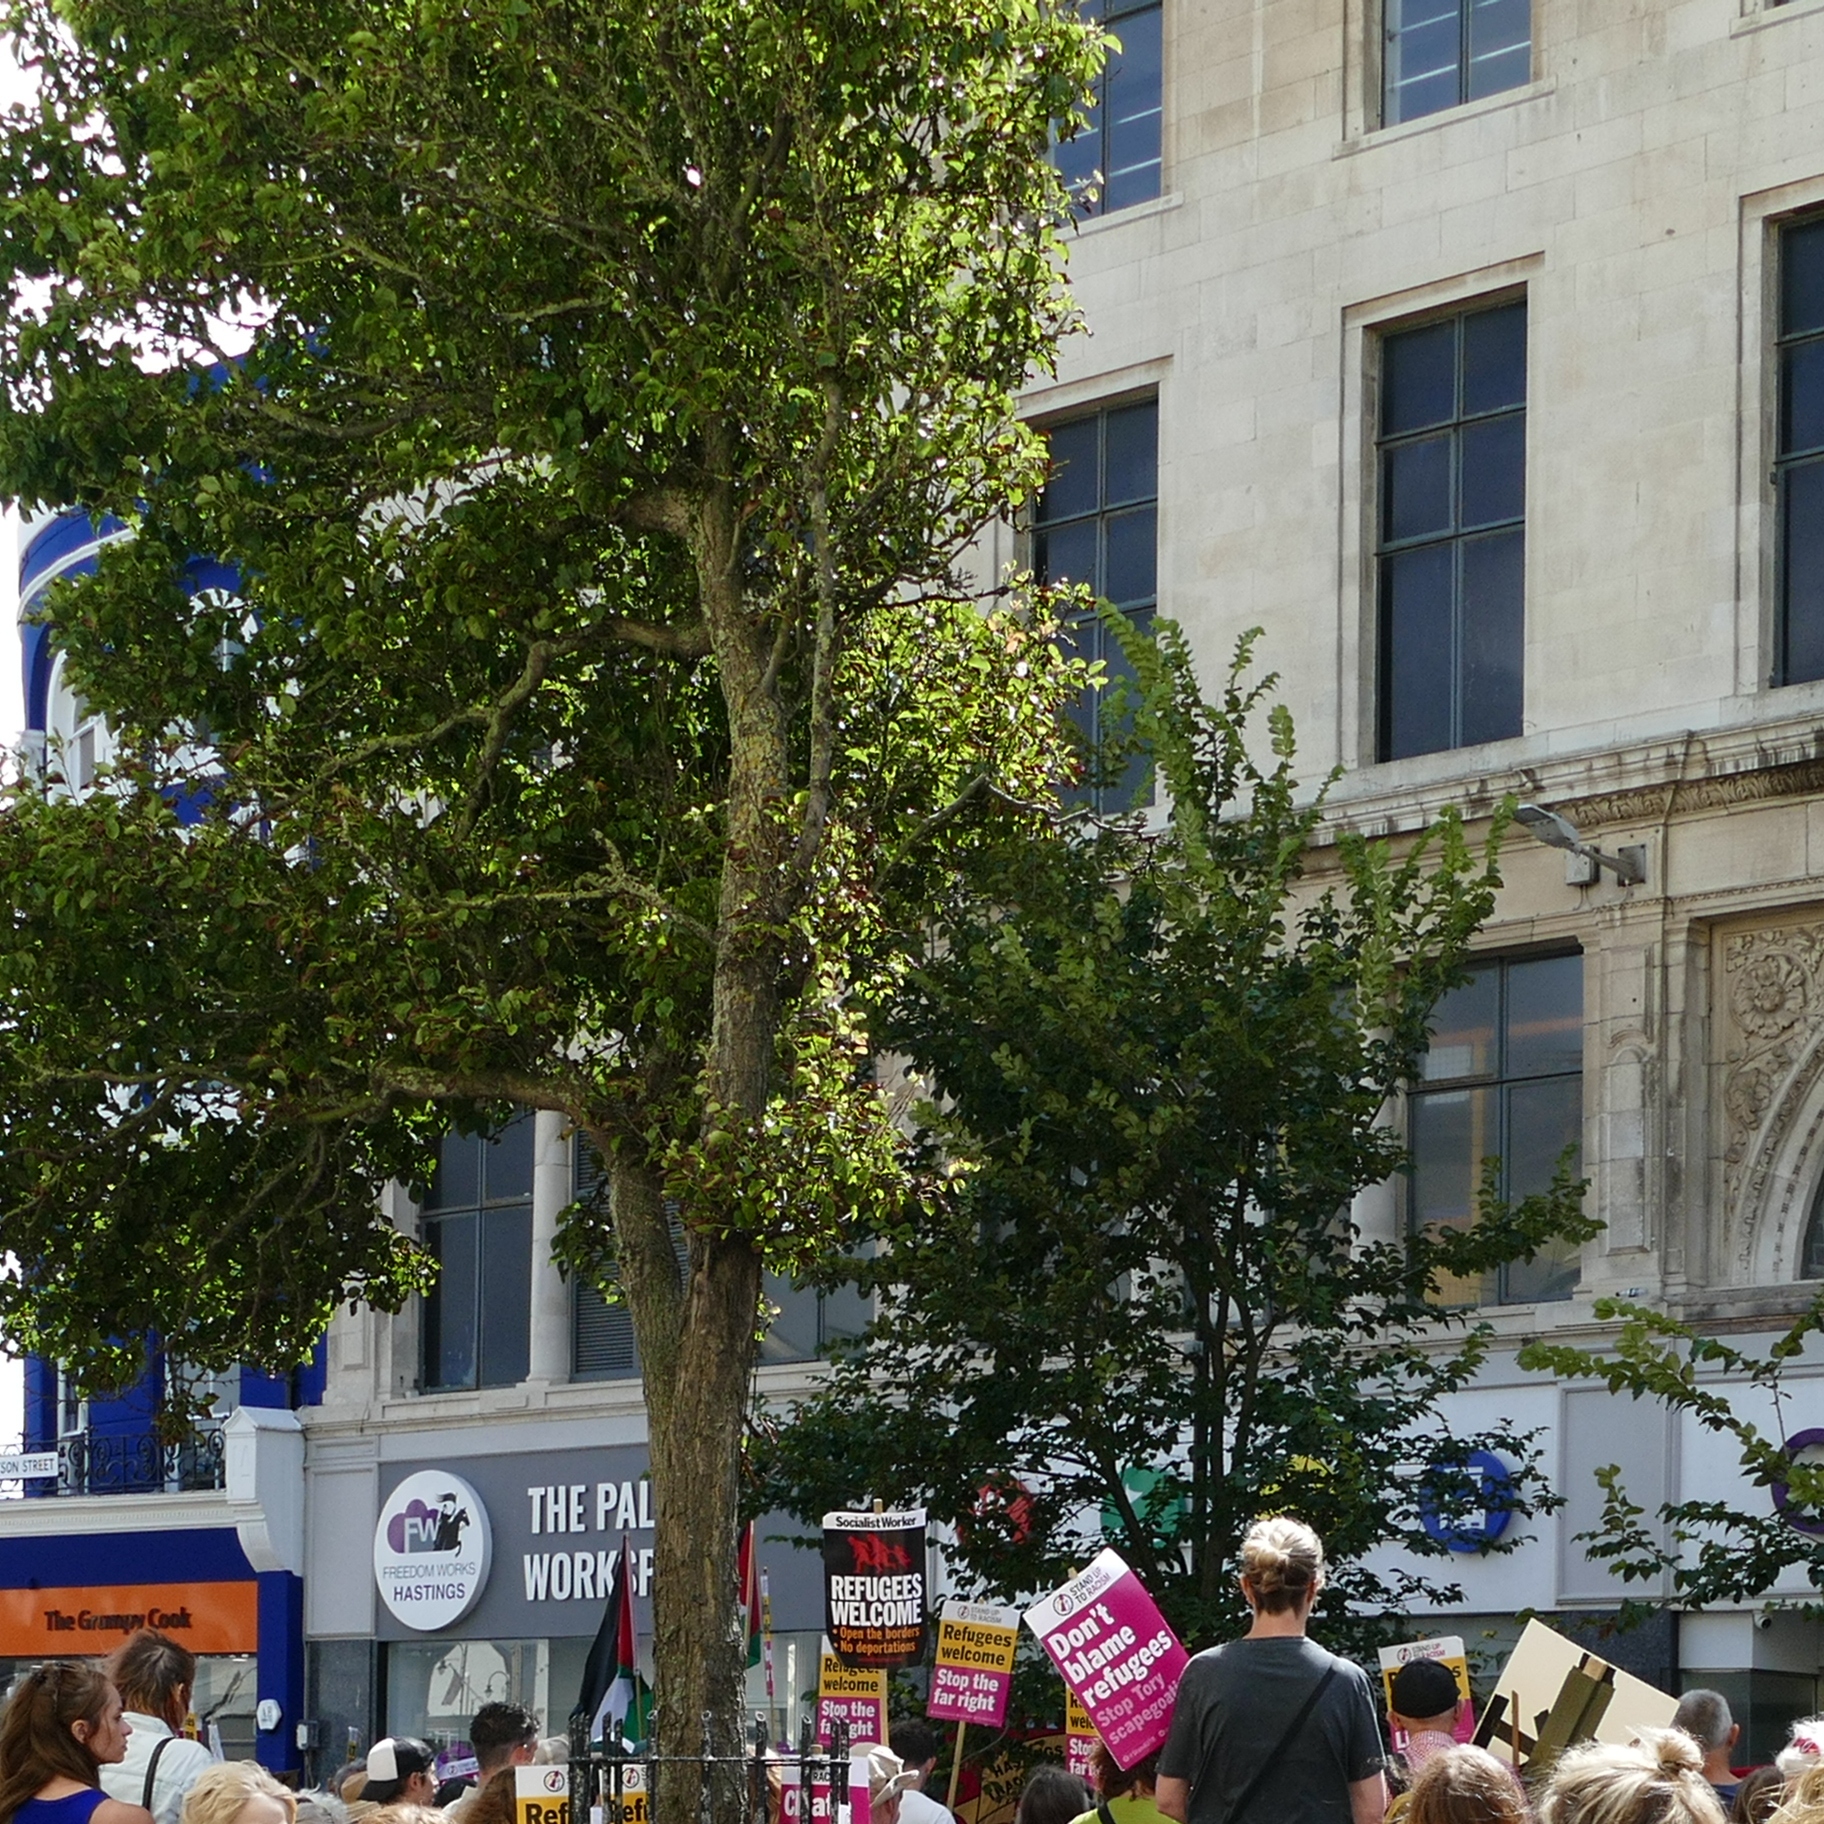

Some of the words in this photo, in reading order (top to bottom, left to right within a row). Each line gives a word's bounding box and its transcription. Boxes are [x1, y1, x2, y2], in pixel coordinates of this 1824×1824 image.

[22, 1457, 55, 1474] STREET
[527, 1484, 587, 1534] THE
[596, 1480, 655, 1531] PAL
[835, 1515, 881, 1529] Socialist
[881, 1516, 917, 1528] Worker
[383, 1563, 436, 1580] FREEDOM
[437, 1562, 476, 1576] WORKS
[523, 1548, 654, 1601] WORKSP
[1070, 1573, 1095, 1596] STAND
[1092, 1565, 1104, 1578] UP
[393, 1582, 465, 1602] HASTINGS
[830, 1572, 923, 1602] REFUGEES
[1076, 1591, 1088, 1604] TO
[1087, 1572, 1111, 1596] RACISM
[44, 1610, 76, 1632] The
[78, 1609, 145, 1635] Grumpy
[147, 1606, 192, 1630] Cook
[830, 1599, 922, 1627] WELCOME
[839, 1627, 864, 1641] Open
[866, 1627, 882, 1640] the
[885, 1626, 920, 1639] borders
[943, 1623, 1013, 1648] Refugees
[1046, 1602, 1115, 1661] Don't
[840, 1641, 854, 1653] No
[856, 1640, 916, 1656] deportations
[941, 1645, 1006, 1666] welcome
[1062, 1625, 1137, 1685] blame
[936, 1668, 969, 1691] Stop
[972, 1672, 999, 1692] the
[1081, 1629, 1173, 1709] refugees
[823, 1676, 879, 1692] welcome
[821, 1699, 848, 1718] Stop
[850, 1701, 876, 1717] the
[933, 1688, 956, 1706] far
[957, 1691, 996, 1712] right
[1095, 1696, 1135, 1728] Stop
[1130, 1671, 1166, 1703] Tory
